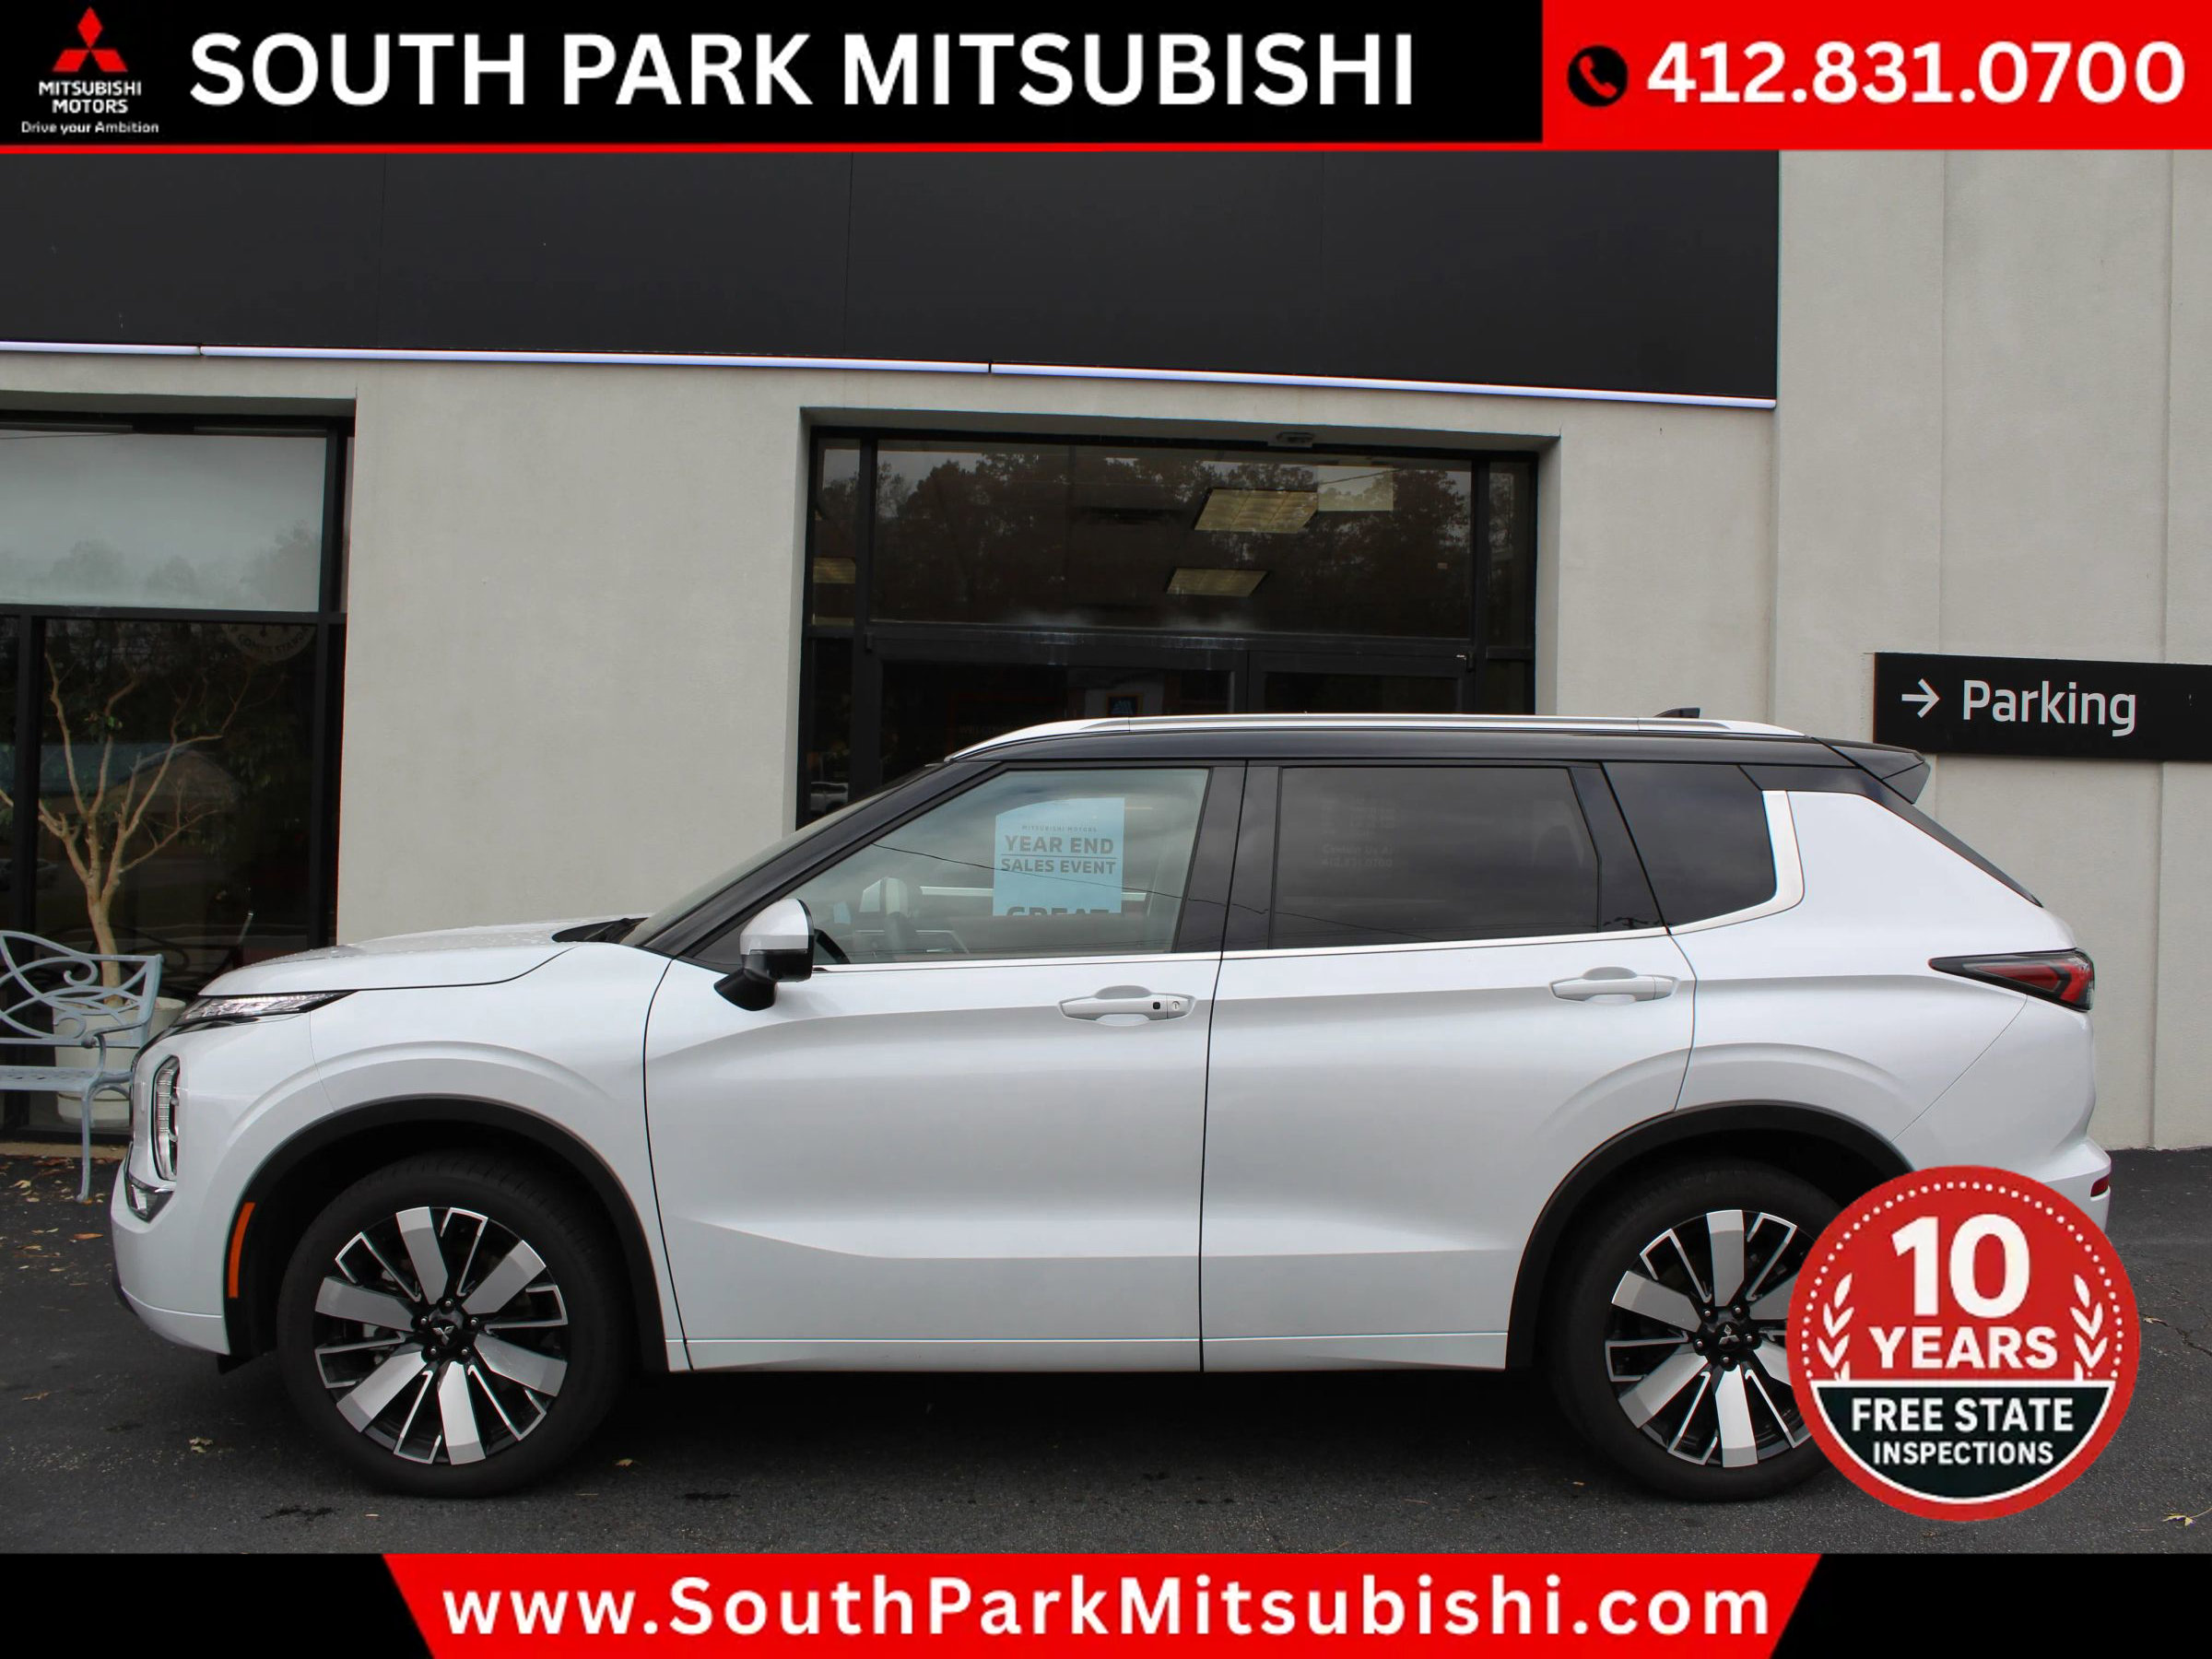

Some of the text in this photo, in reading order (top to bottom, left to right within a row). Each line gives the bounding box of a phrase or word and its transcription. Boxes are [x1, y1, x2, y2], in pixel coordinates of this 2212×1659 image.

[1963, 679, 2136, 737] Parking
[1005, 835, 1114, 854] YEAR END
[1001, 858, 1116, 875] SALES EVENT
